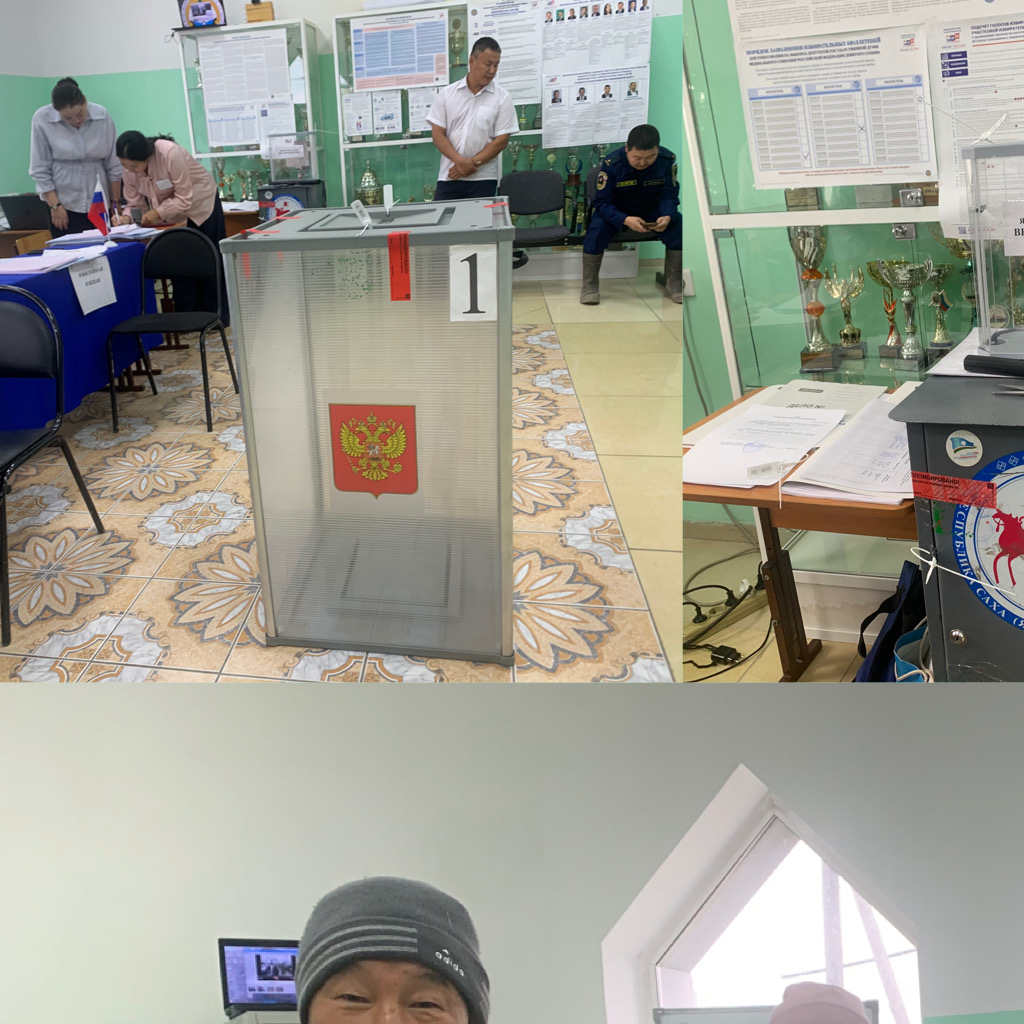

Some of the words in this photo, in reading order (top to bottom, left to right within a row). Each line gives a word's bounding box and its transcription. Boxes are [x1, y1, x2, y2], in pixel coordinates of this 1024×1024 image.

[460, 252, 486, 314] 1
[955, 503, 975, 585] ЕСПУБЛИКА
[976, 587, 1005, 617] САХА
